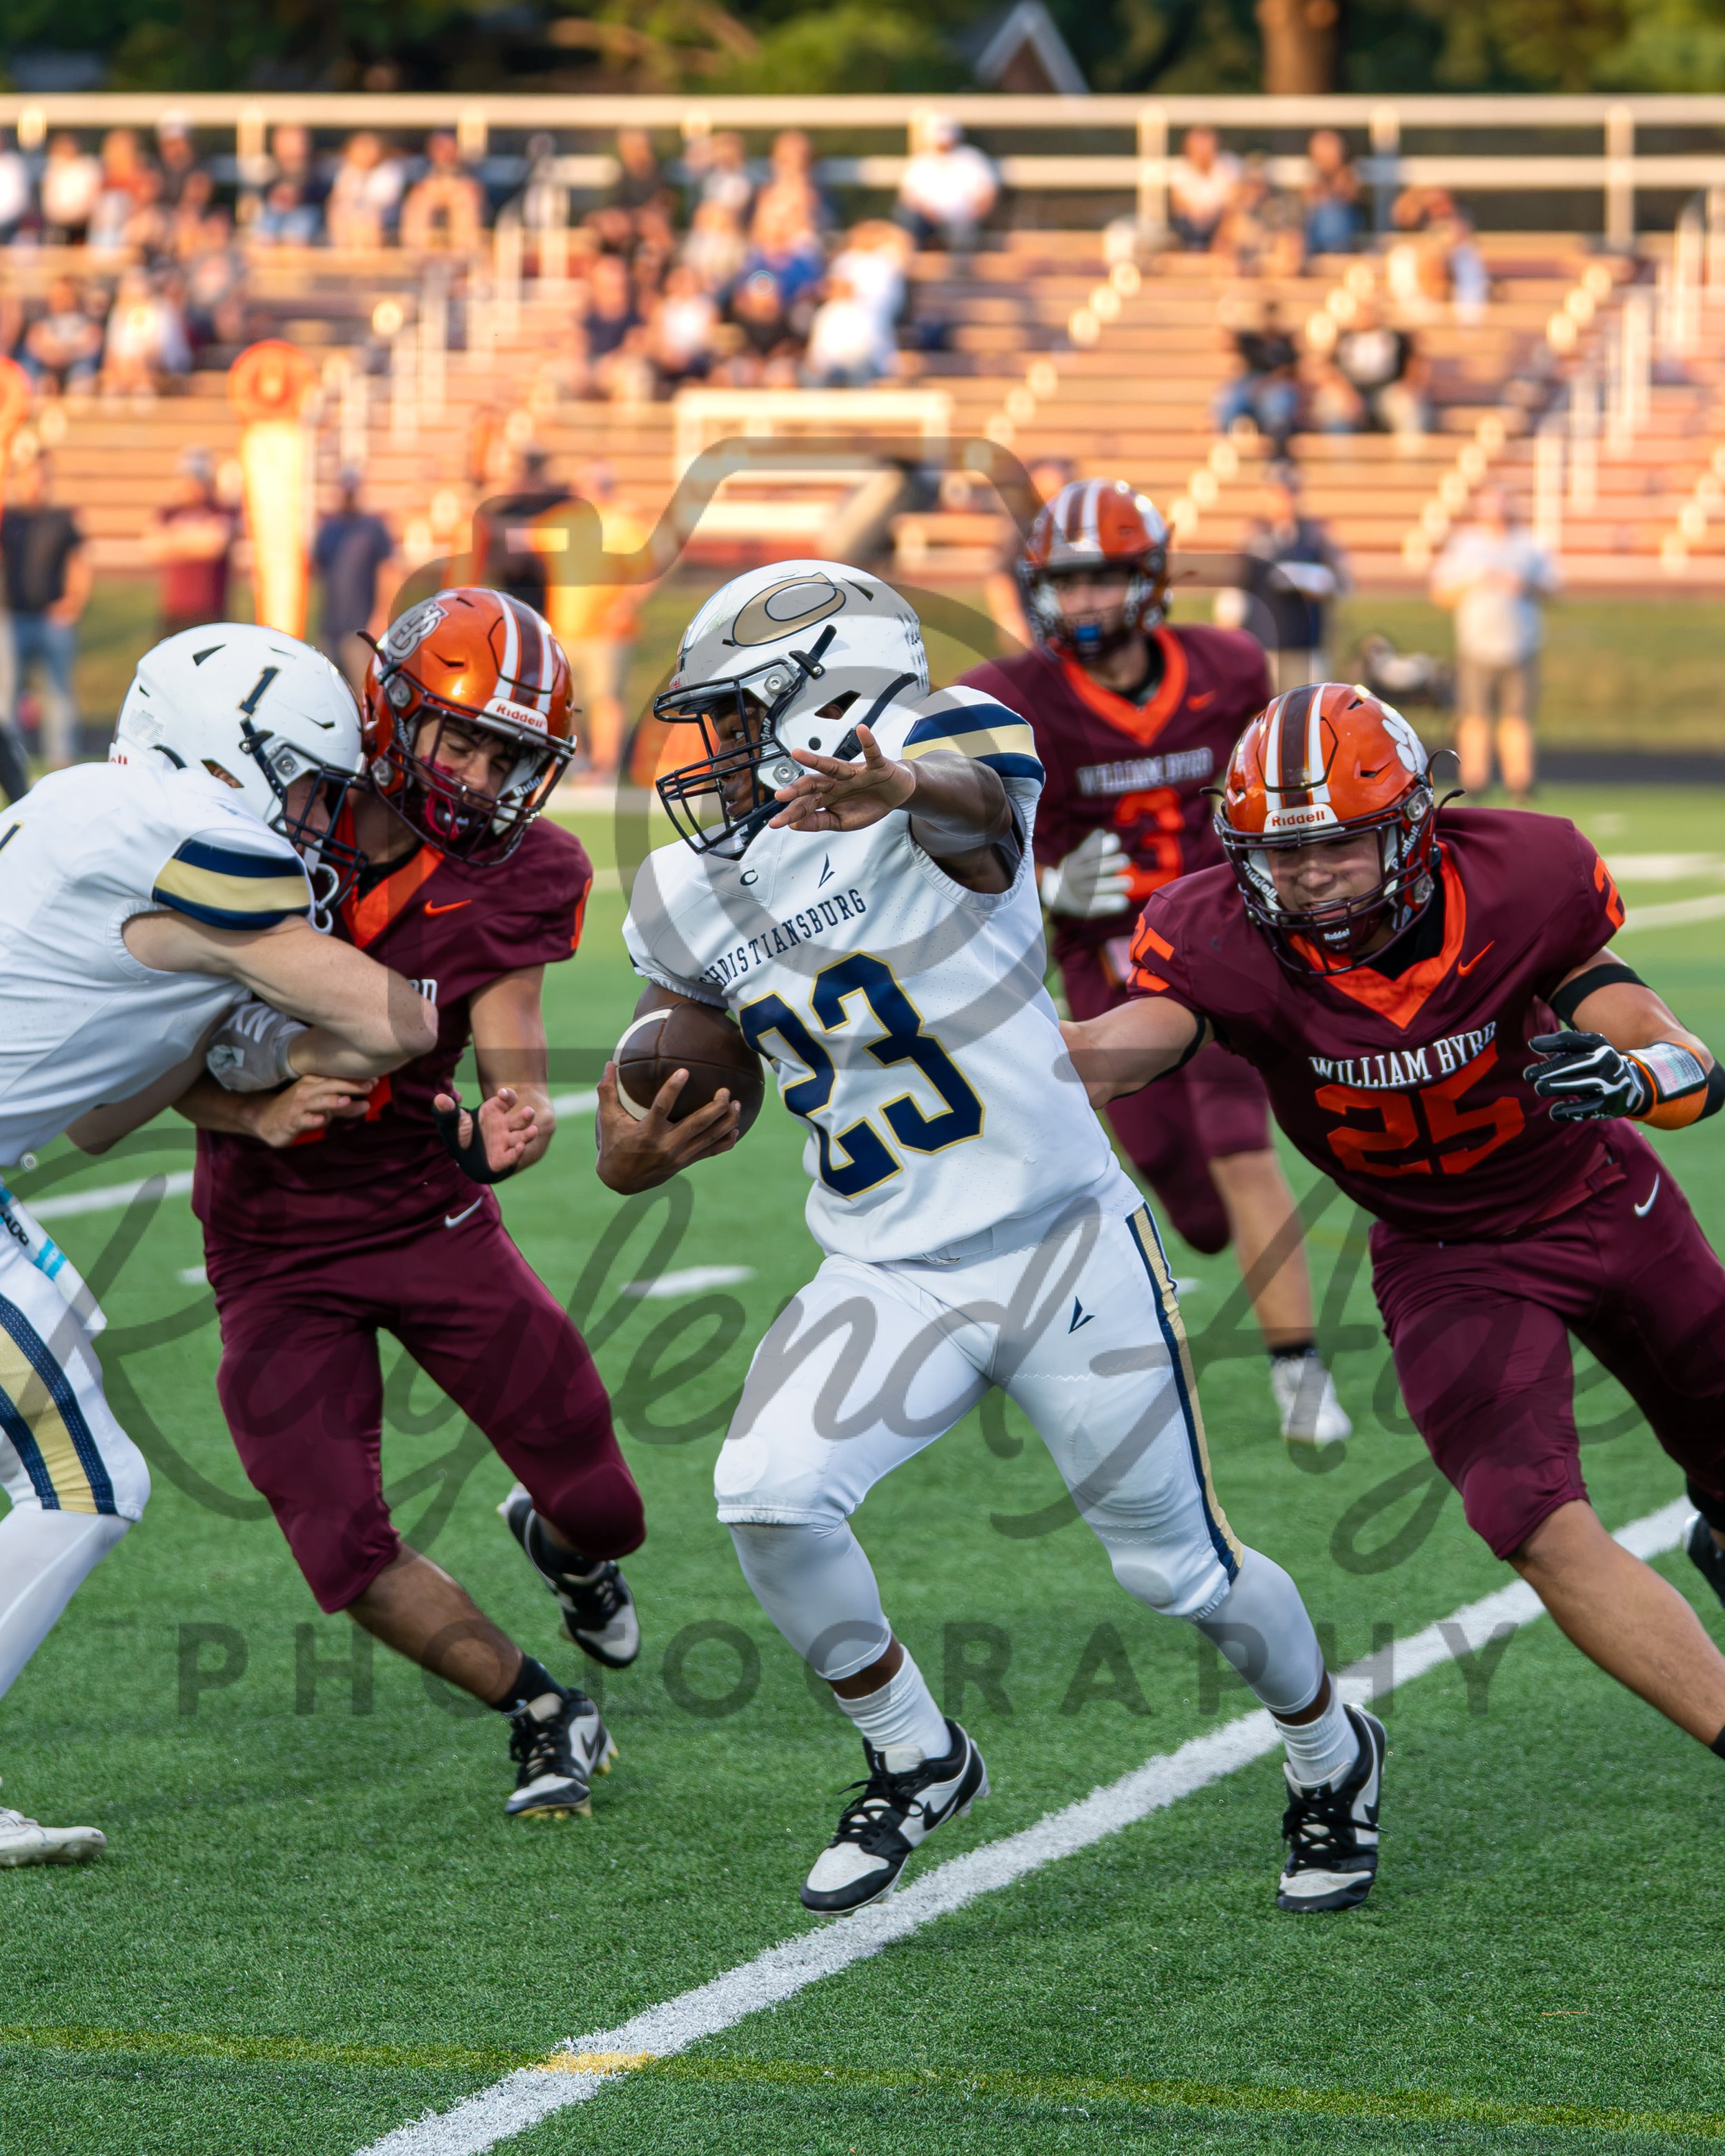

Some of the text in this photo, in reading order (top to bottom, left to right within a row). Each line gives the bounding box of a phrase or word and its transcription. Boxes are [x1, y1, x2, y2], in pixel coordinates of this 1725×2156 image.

[235, 664, 283, 718] 1
[495, 702, 544, 729] Riddell
[1113, 785, 1185, 901] 3
[1272, 810, 1325, 827] Riddell
[740, 869, 759, 887] C
[738, 949, 985, 1199] 23
[1308, 1021, 1497, 1089] WILLIAM BYRD
[1314, 1040, 1526, 1177] 25
